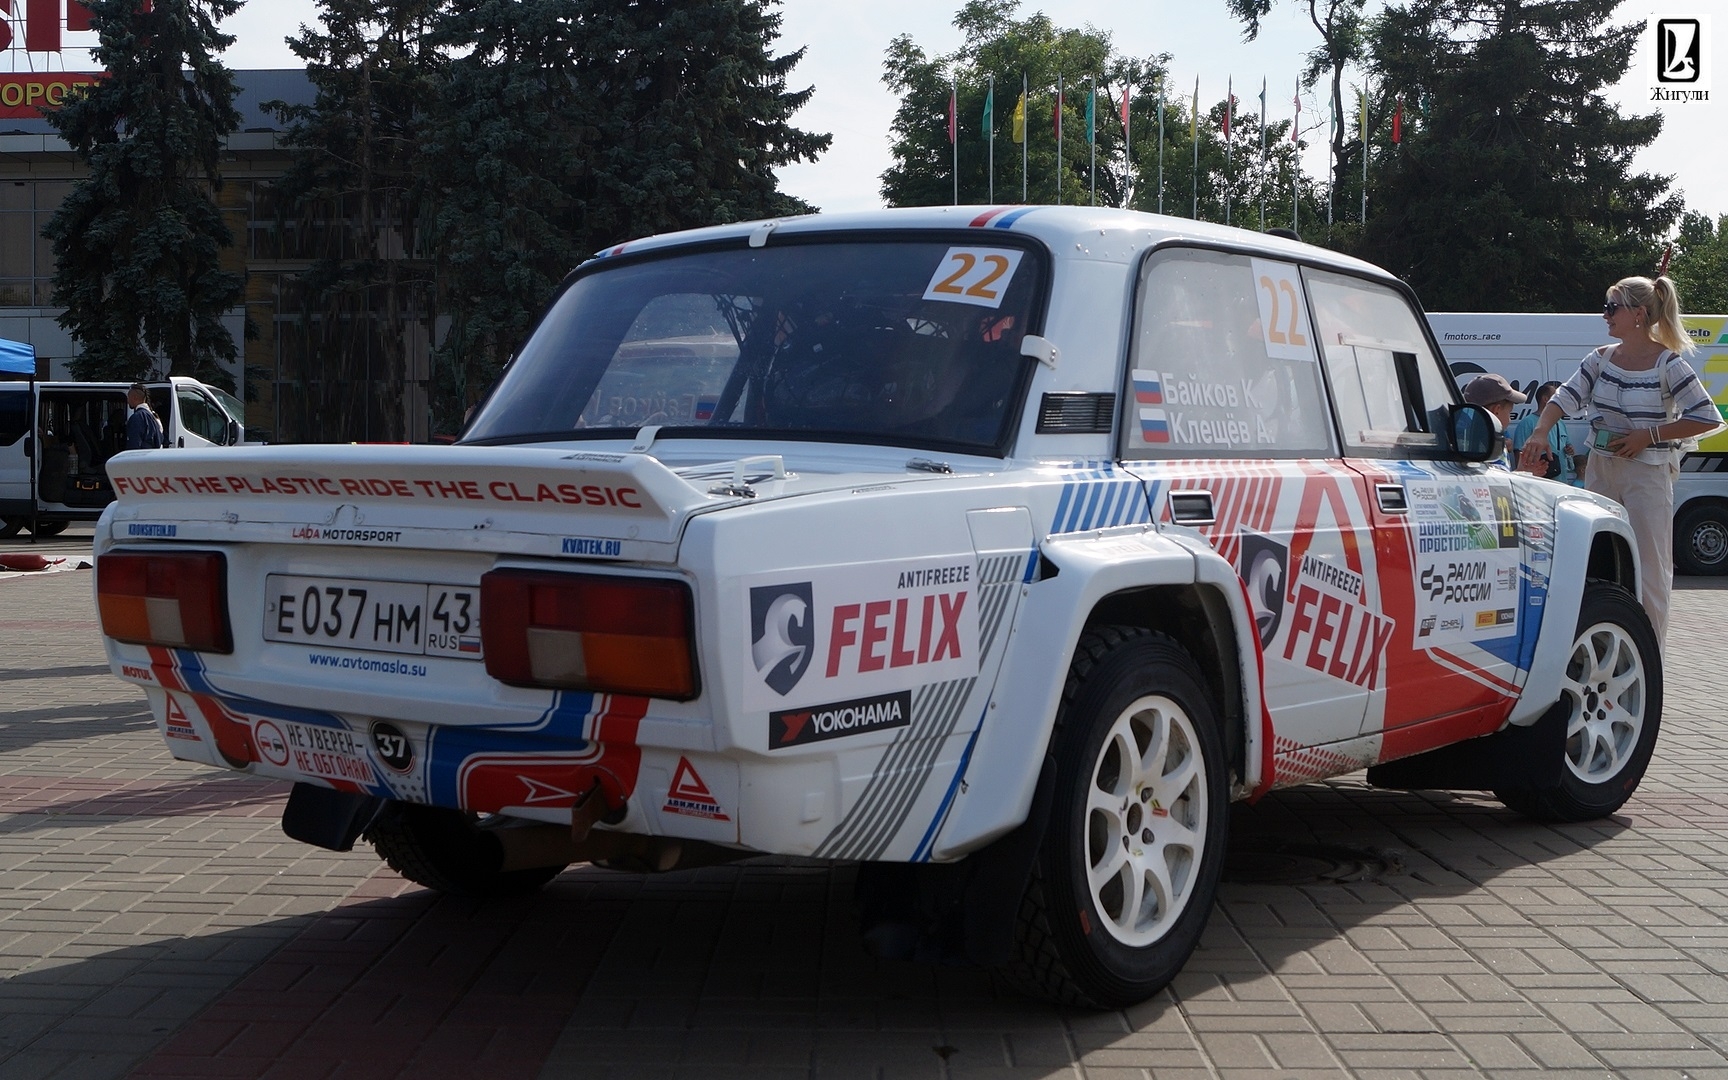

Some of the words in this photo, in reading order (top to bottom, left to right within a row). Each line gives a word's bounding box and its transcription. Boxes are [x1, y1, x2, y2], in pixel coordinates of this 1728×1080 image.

[932, 252, 1009, 299] 22
[1259, 275, 1307, 346] 22
[1444, 332, 1501, 341] fmotors_race
[1161, 372, 1239, 407] Байков
[1169, 412, 1250, 449] Клещёв
[1257, 414, 1277, 444] А.
[113, 476, 177, 495] FUCK
[174, 477, 228, 494] THE
[225, 476, 340, 496] PLASTIC
[339, 478, 415, 498] RIDE
[413, 480, 485, 500] THE
[488, 481, 642, 508] CLASSIC
[1418, 521, 1469, 536] ДОНСКИЕ
[1497, 496, 1514, 537] 22
[291, 527, 320, 540] LADA
[321, 529, 402, 543] MOTORSPORT
[561, 537, 622, 556] KVATEK.RU
[1419, 537, 1480, 553] ПРОСТОРЫ
[898, 565, 970, 589] ANTIFREEZE
[1302, 555, 1361, 596] ANTIFREEZE
[1447, 561, 1487, 582] РАЛЛИ
[1444, 582, 1491, 604] РОССИИ
[432, 592, 471, 633] 43
[428, 633, 457, 650] RUS
[825, 591, 968, 679] FELIX
[1283, 583, 1393, 691] FELIX
[122, 665, 152, 680] MOTUL
[309, 653, 427, 676] www.avtomasla.su
[811, 700, 902, 733] YOKOHAMA
[286, 724, 305, 748] НЕ
[376, 733, 406, 758] 37
[293, 750, 313, 772] НЕ
[314, 754, 375, 783] ОБГОНЯЙ!
[667, 799, 721, 813] ДВИЖЕНИЕ
